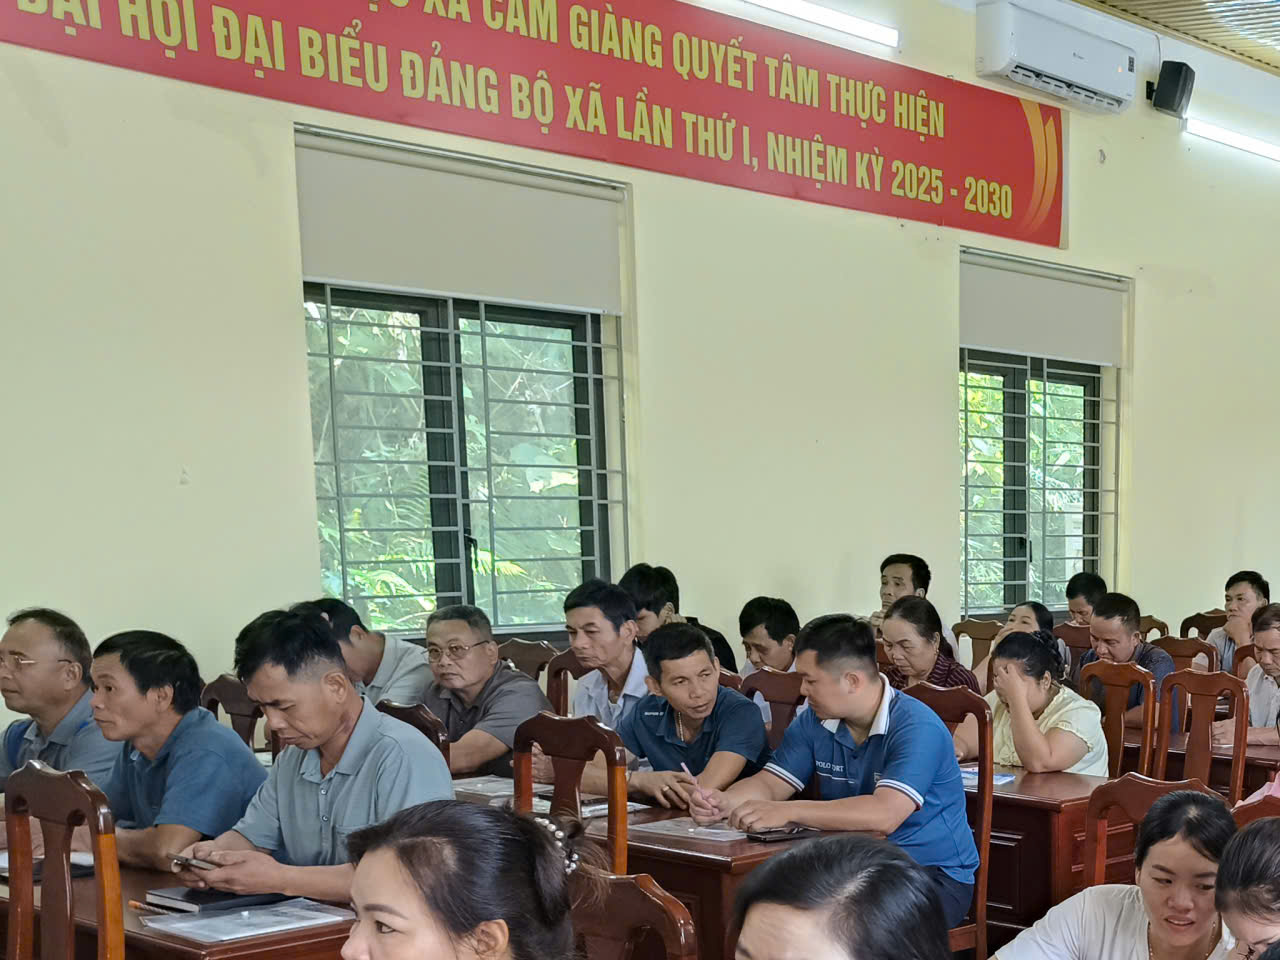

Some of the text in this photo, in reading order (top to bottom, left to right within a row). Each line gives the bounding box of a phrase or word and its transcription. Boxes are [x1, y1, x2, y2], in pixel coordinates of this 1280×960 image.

[211, 4, 286, 79] ĐẠI
[298, 19, 389, 93] BIỂU
[400, 41, 500, 115] ĐẢNG
[510, 70, 555, 135] BỘ
[564, 81, 608, 136] XÃ
[616, 87, 674, 149] LẦN
[681, 111, 737, 162] THỨ
[742, 125, 759, 172] I,
[767, 133, 849, 190] NHIỆM
[855, 146, 885, 193] KỲ
[891, 159, 944, 205] 2025
[964, 175, 1014, 220] 2030
[569, 3, 663, 69] GIÀNG
[672, 35, 757, 92] QUYẾT
[764, 53, 820, 108] TÂM
[826, 73, 887, 129] THỰC
[894, 89, 945, 143] HIỆN
